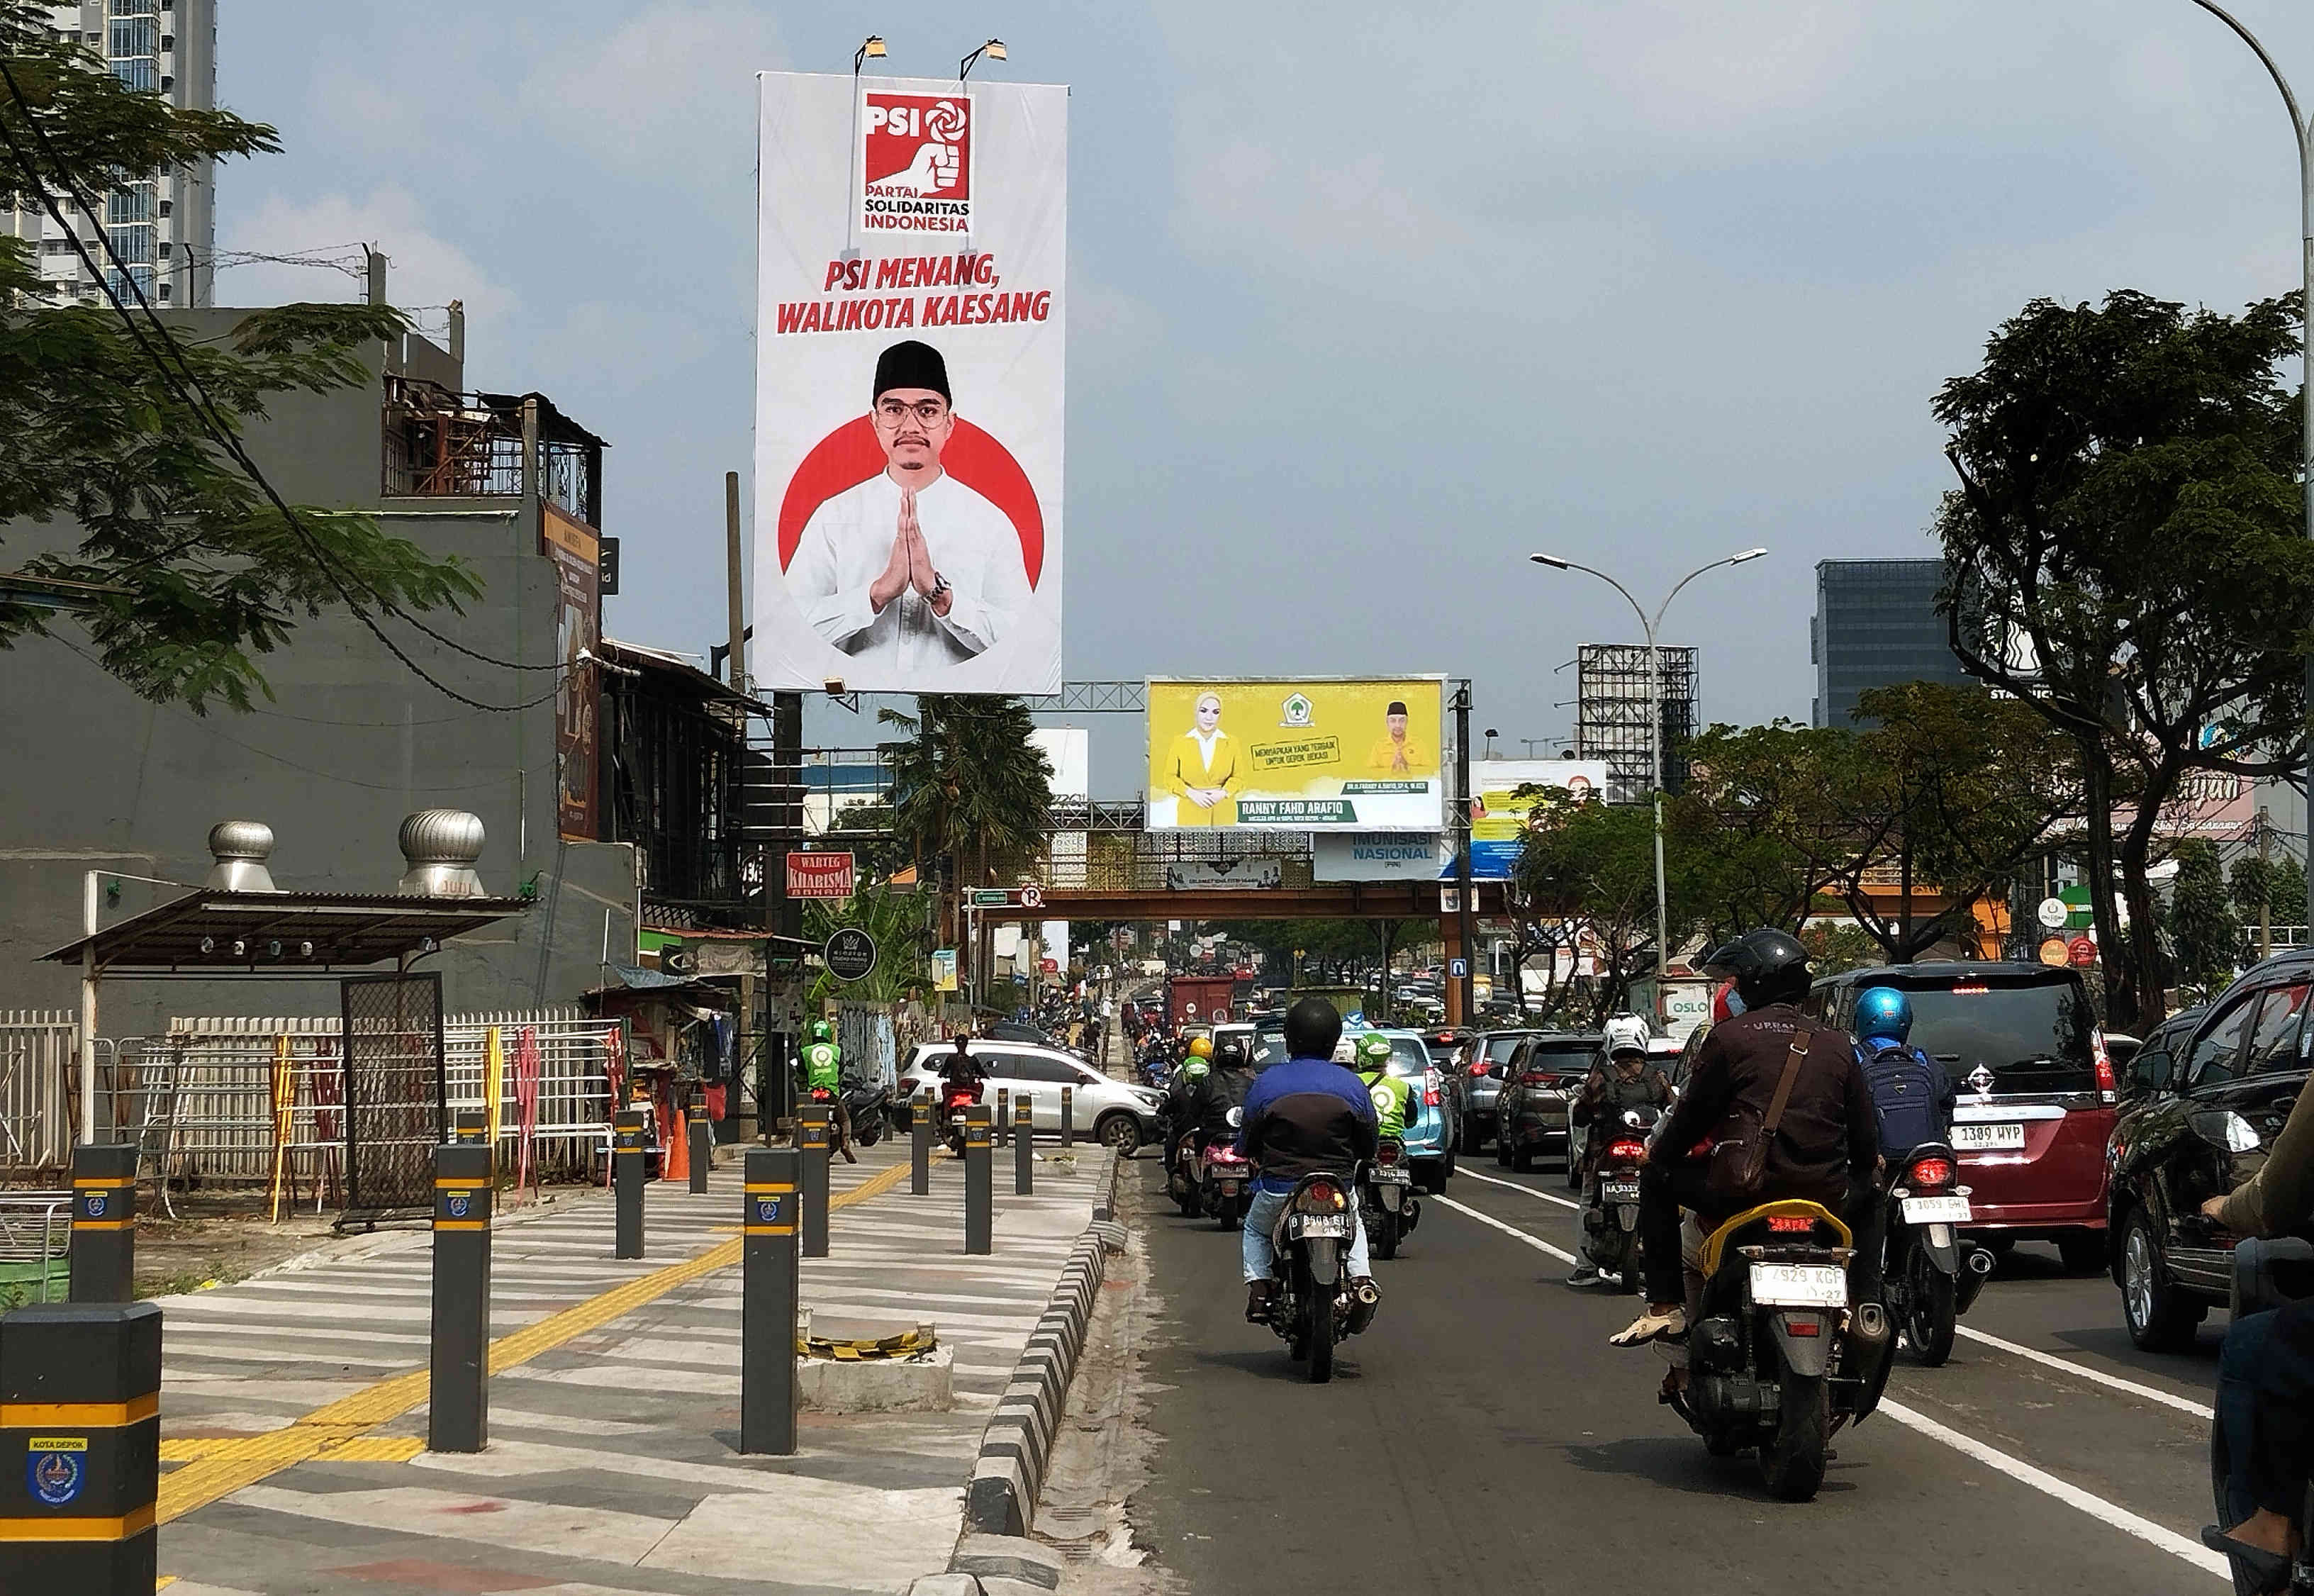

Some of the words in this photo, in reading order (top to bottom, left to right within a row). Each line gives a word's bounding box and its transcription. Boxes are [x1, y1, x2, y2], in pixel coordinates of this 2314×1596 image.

[866, 106, 920, 137] PSI
[865, 185, 918, 199] PARTAI
[865, 199, 970, 216] SOLIDARITAS
[865, 213, 969, 233] INDONESIA
[824, 259, 871, 291] PSI
[875, 252, 1000, 289] MENANG,
[776, 297, 914, 334] WALIKOTA
[921, 290, 1051, 327] KAESANG
[1293, 744, 1309, 753] YANG
[1242, 802, 1276, 815] RANNY
[1279, 802, 1304, 815] FAHD
[1307, 802, 1343, 815] ARAFIQ
[1353, 833, 1432, 845] IMUNISASI
[1353, 848, 1433, 859] NASIONAL
[801, 856, 840, 868] WARTEG
[789, 866, 851, 888] KHARISMA
[1673, 1002, 1708, 1012] OSLO
[1816, 1270, 1842, 1284] KGF
